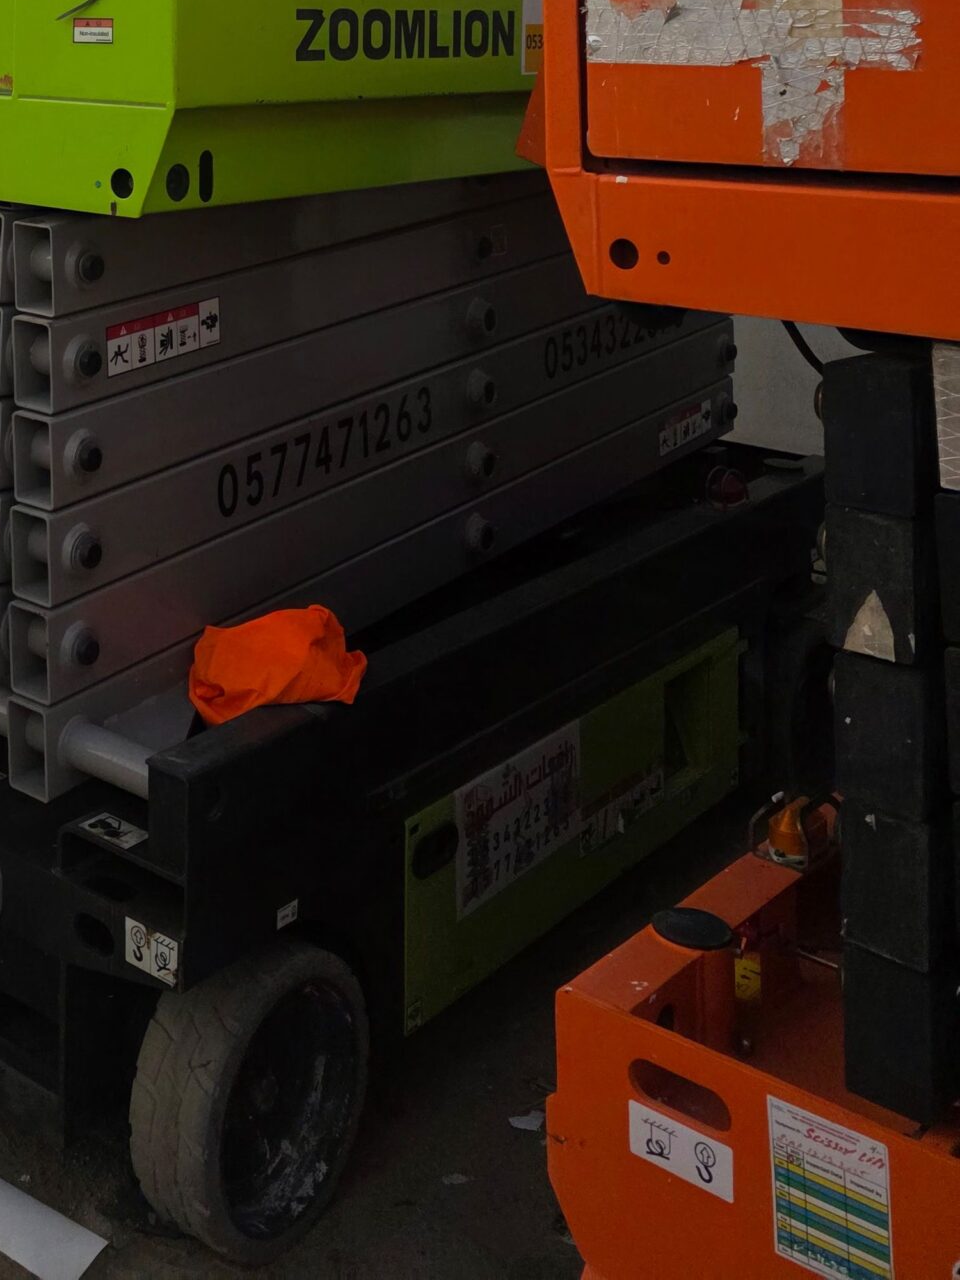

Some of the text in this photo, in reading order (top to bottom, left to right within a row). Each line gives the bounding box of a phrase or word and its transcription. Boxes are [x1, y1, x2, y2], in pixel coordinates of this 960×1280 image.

[295, 7, 516, 62] ZOOMLION
[544, 312, 684, 379] 0534322
[217, 386, 433, 518] 0577471263
